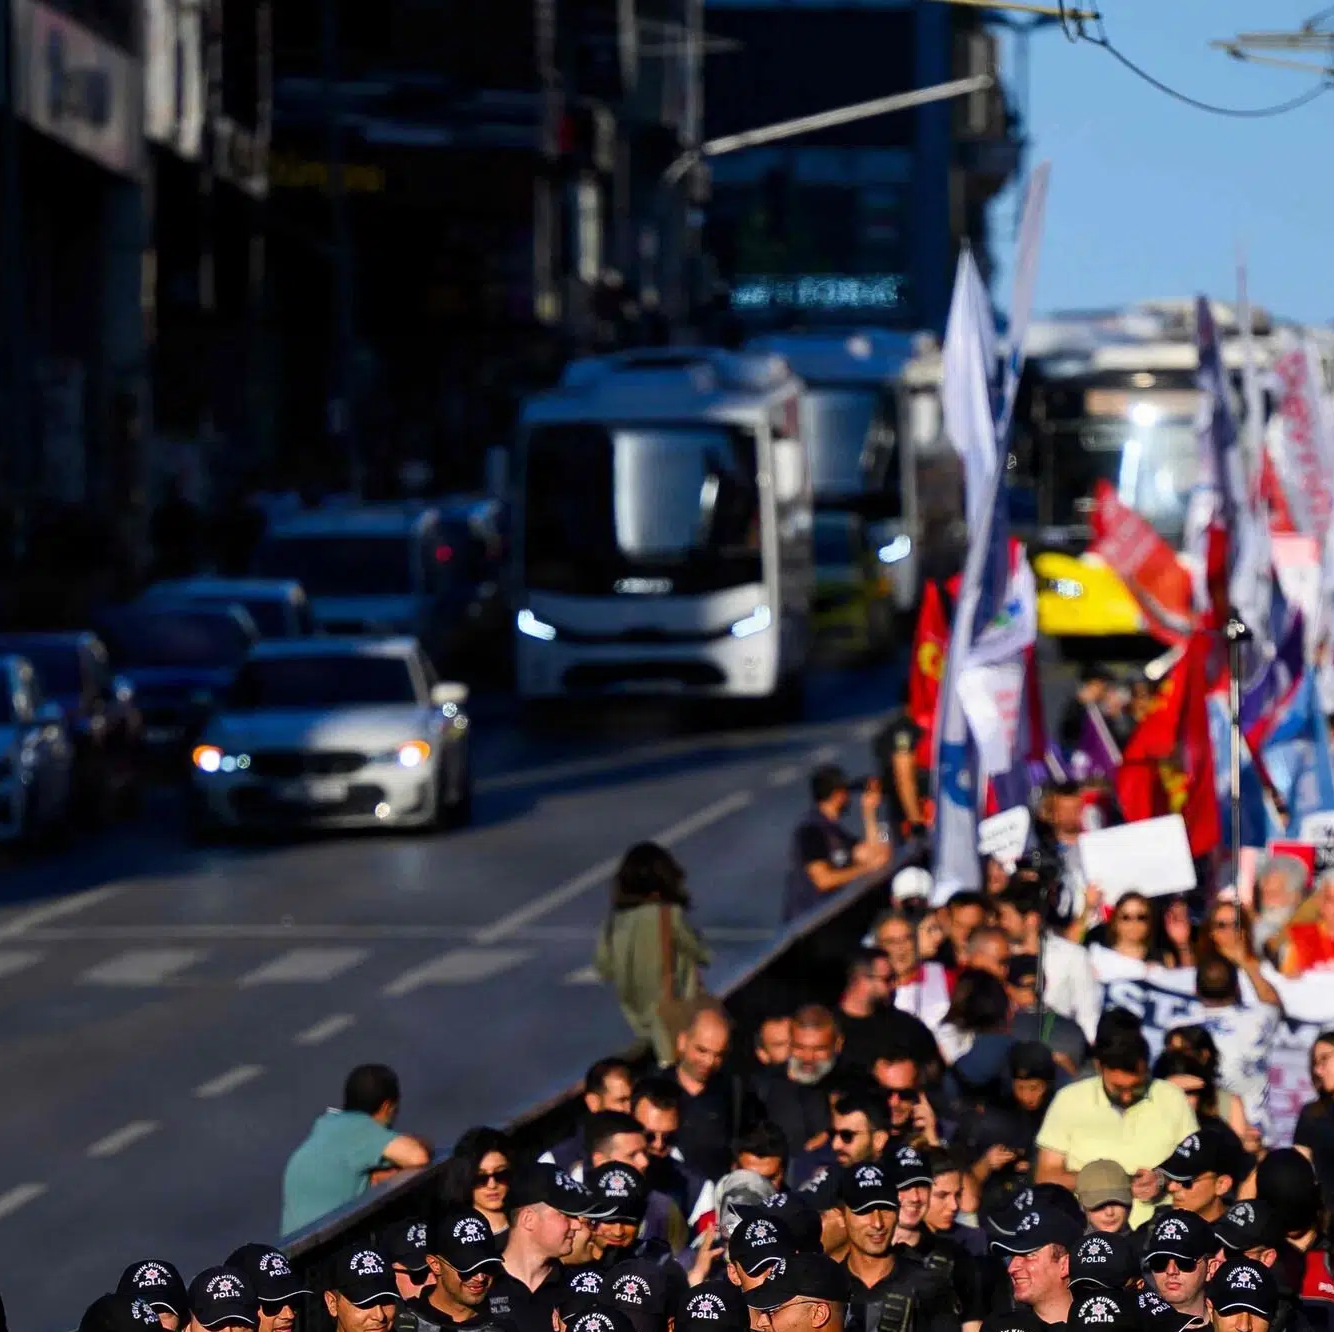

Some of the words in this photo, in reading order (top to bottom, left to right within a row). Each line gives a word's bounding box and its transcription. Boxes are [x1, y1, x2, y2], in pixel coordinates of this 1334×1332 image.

[213, 1289, 240, 1300] POLİS
[615, 1291, 642, 1305] POLİS
[691, 1309, 719, 1320] POLİS
[1084, 1313, 1115, 1324] POLİS
